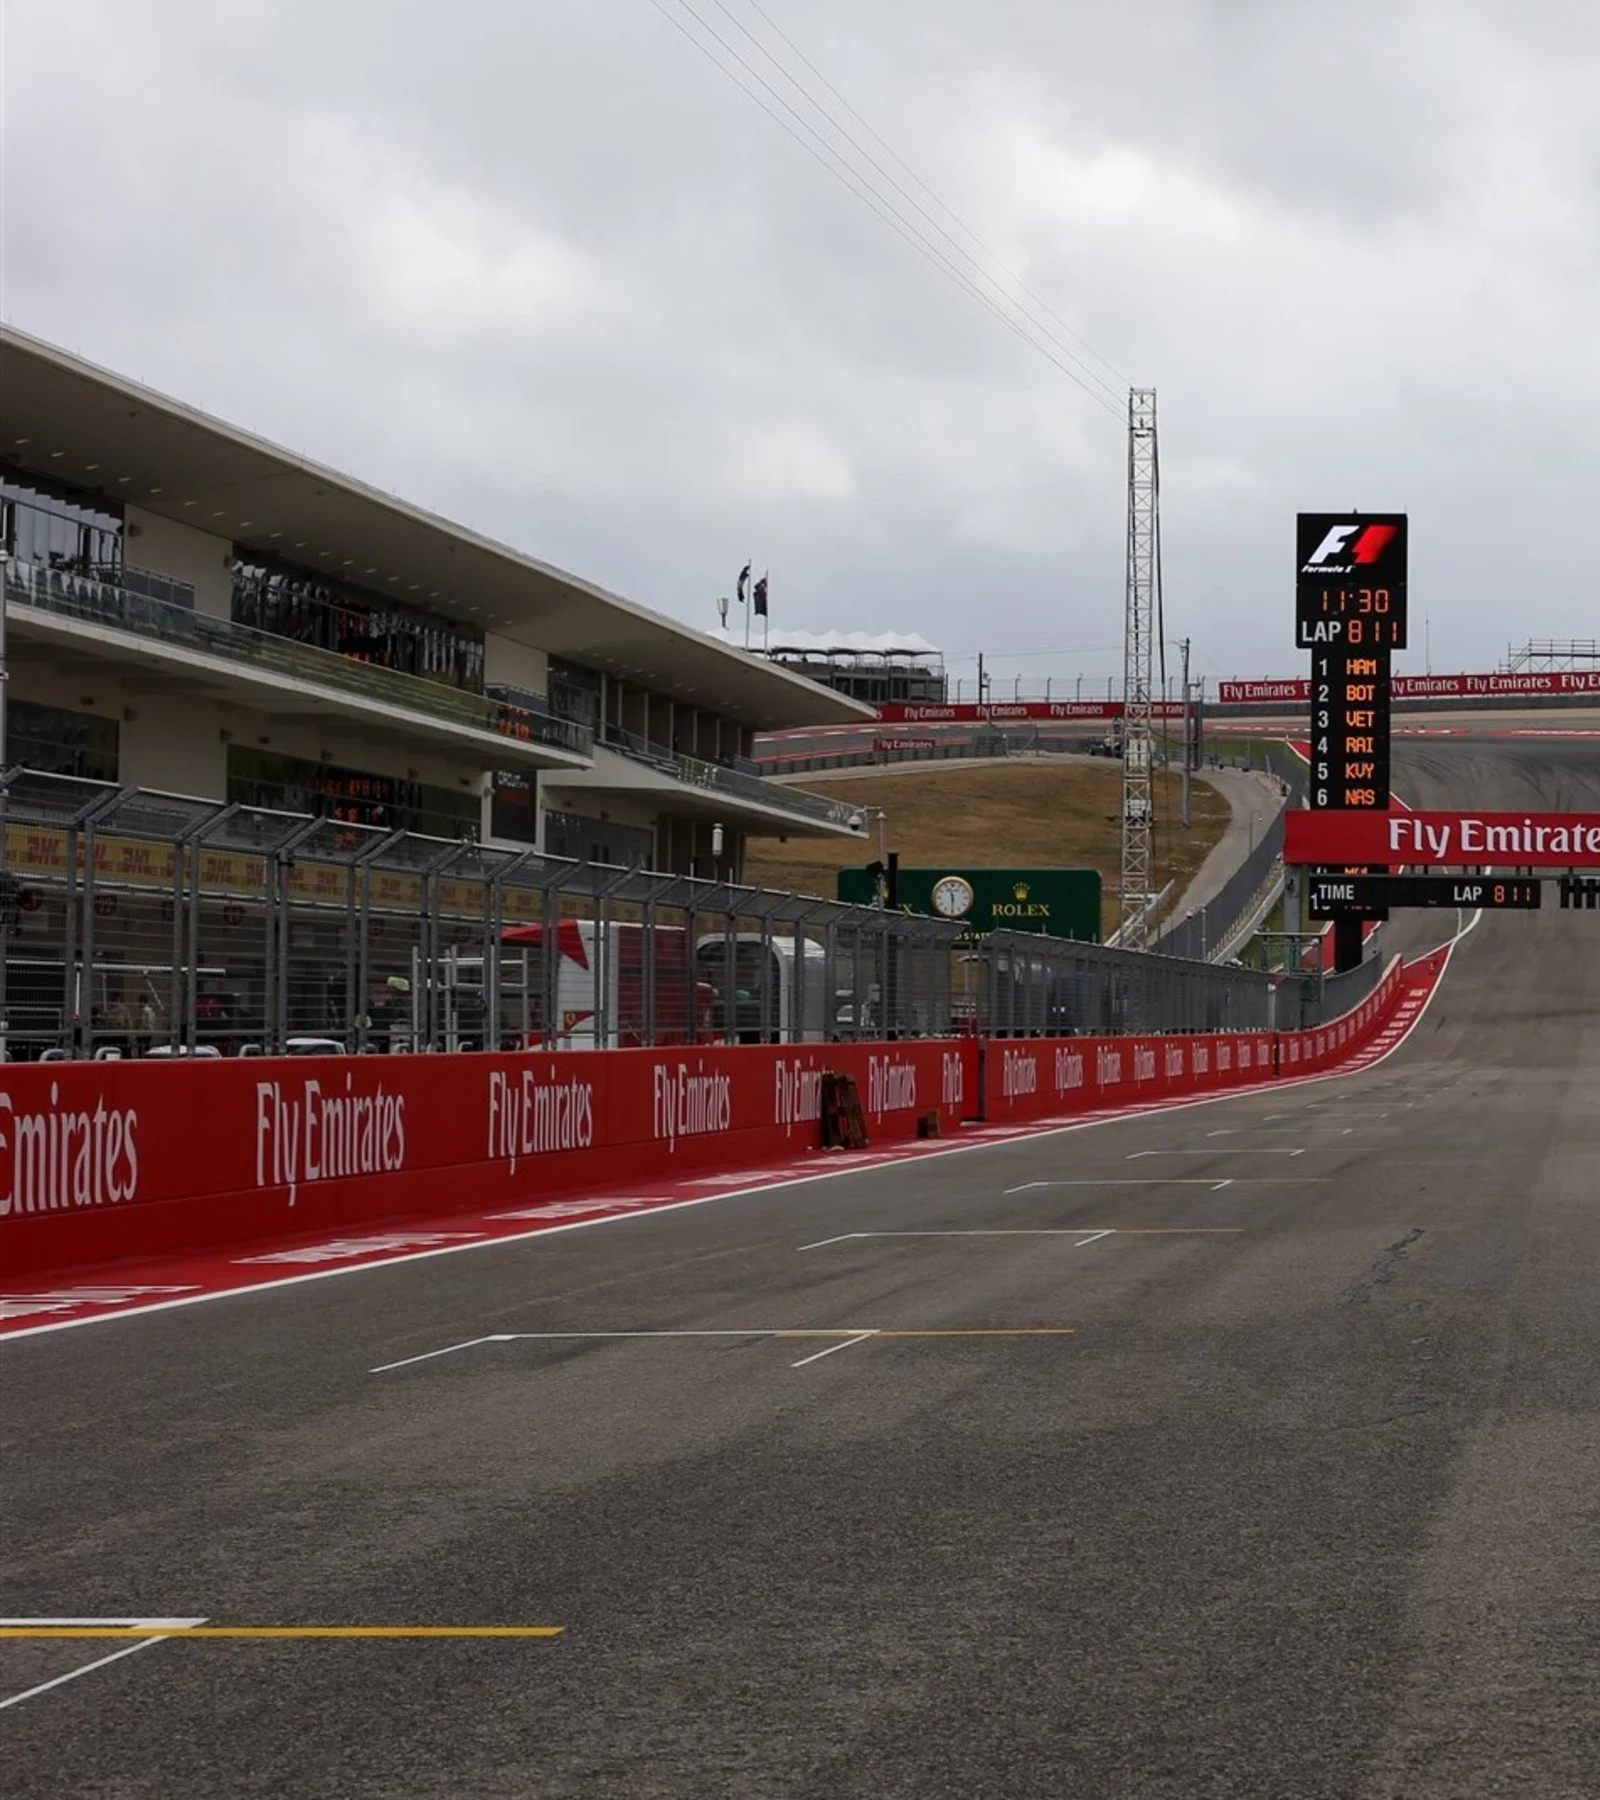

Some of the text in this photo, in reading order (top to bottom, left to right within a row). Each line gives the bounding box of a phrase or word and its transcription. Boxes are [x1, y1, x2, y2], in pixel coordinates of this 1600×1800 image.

[1301, 564, 1344, 574] Formula
[1302, 620, 1342, 642] LAP
[1319, 658, 1377, 676] 1 HAM
[1223, 685, 1243, 700] Fly
[1245, 684, 1296, 698] Emirates
[1391, 678, 1459, 695] ly Emirates
[1466, 675, 1552, 696] Fly Emirates
[1561, 674, 1585, 693] Fly
[1318, 684, 1329, 702] 2
[1346, 684, 1375, 702] BOT
[1318, 710, 1375, 728] 3 VET
[1318, 736, 1374, 753] 4 RAI
[1318, 762, 1375, 780] 5 KVY
[1317, 788, 1375, 806] 6 NAS
[1388, 820, 1450, 859] Fly
[1318, 884, 1354, 900] TIME
[1454, 885, 1482, 901] LAP
[991, 904, 1051, 917] ROLEX
[775, 1055, 826, 1138] Fly Emira
[868, 1051, 917, 1125] Fly Emirates
[654, 1058, 731, 1153] Fly Emirates
[488, 1064, 594, 1176] Fly Emirates
[256, 1072, 405, 1207] Fly Emirates
